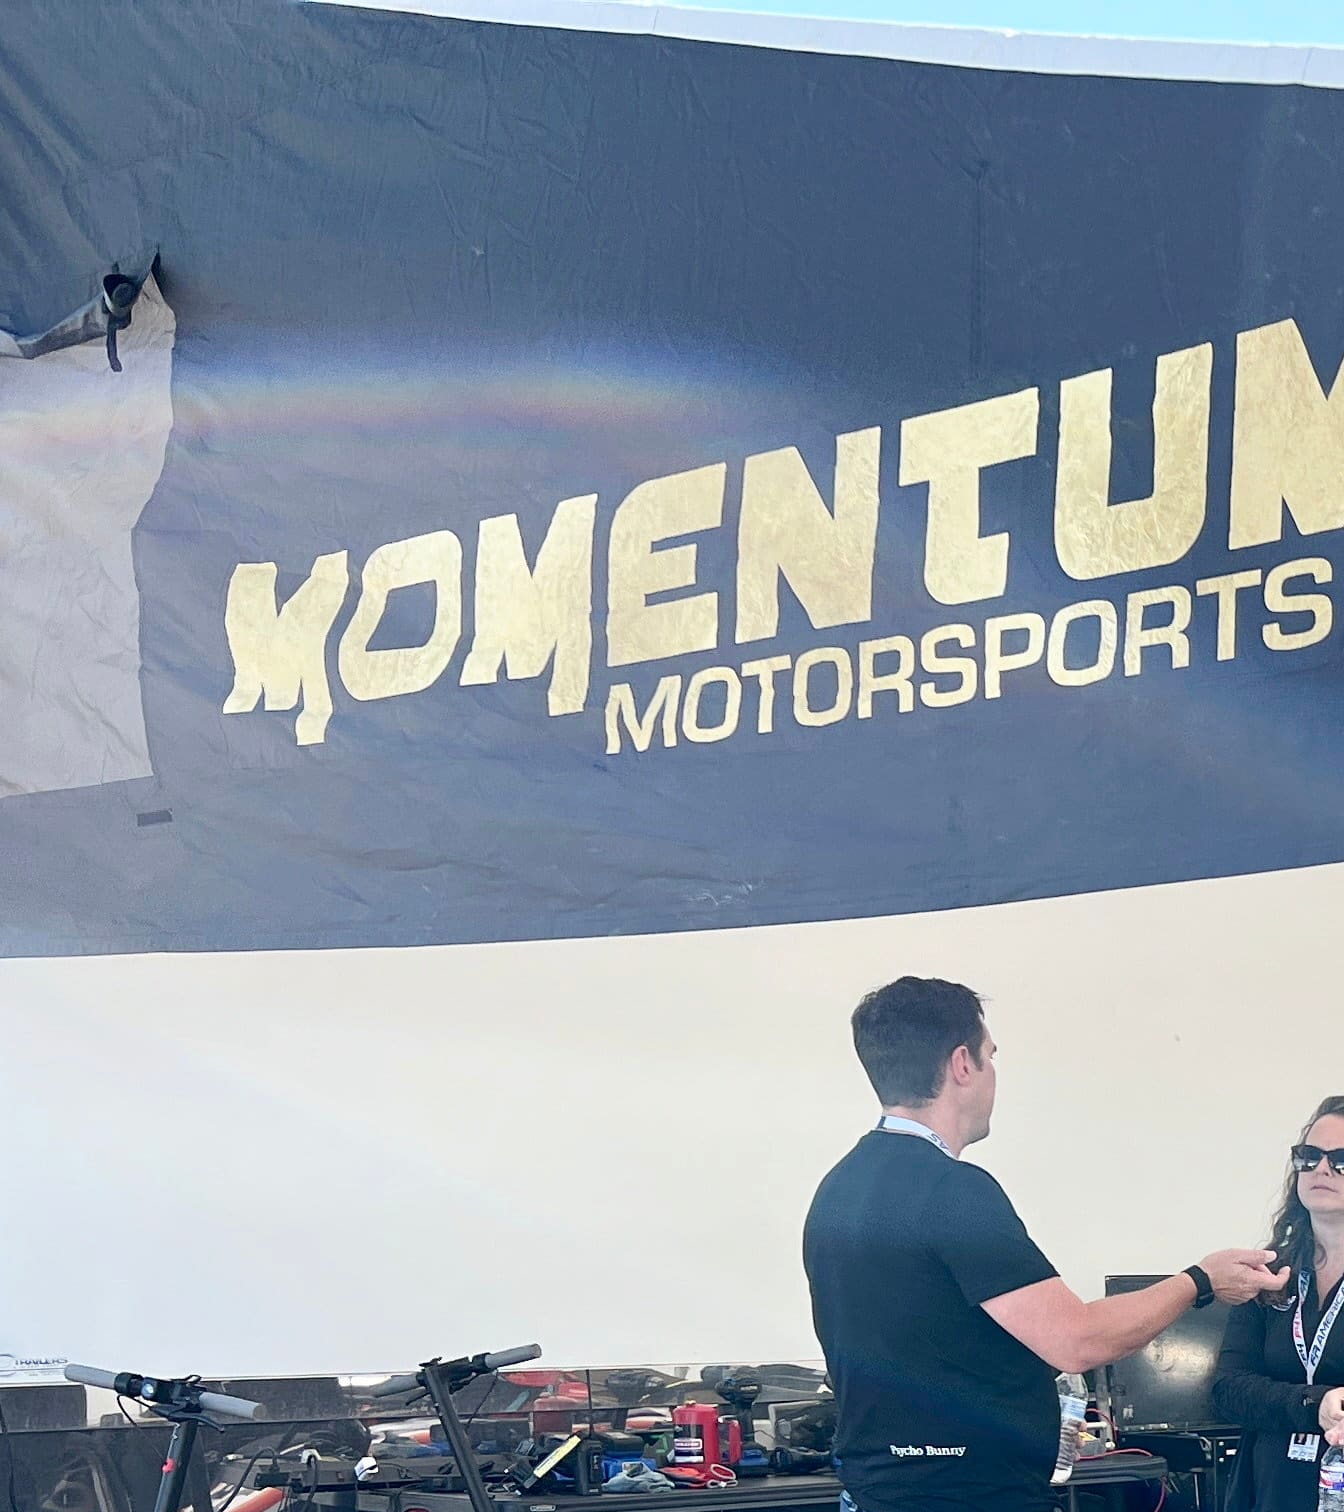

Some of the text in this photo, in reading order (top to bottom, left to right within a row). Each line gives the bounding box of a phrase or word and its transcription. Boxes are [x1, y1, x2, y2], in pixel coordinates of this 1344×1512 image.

[605, 557, 1333, 754] MOTORSPORTS
[890, 1445, 966, 1457] Psycho Bunny
